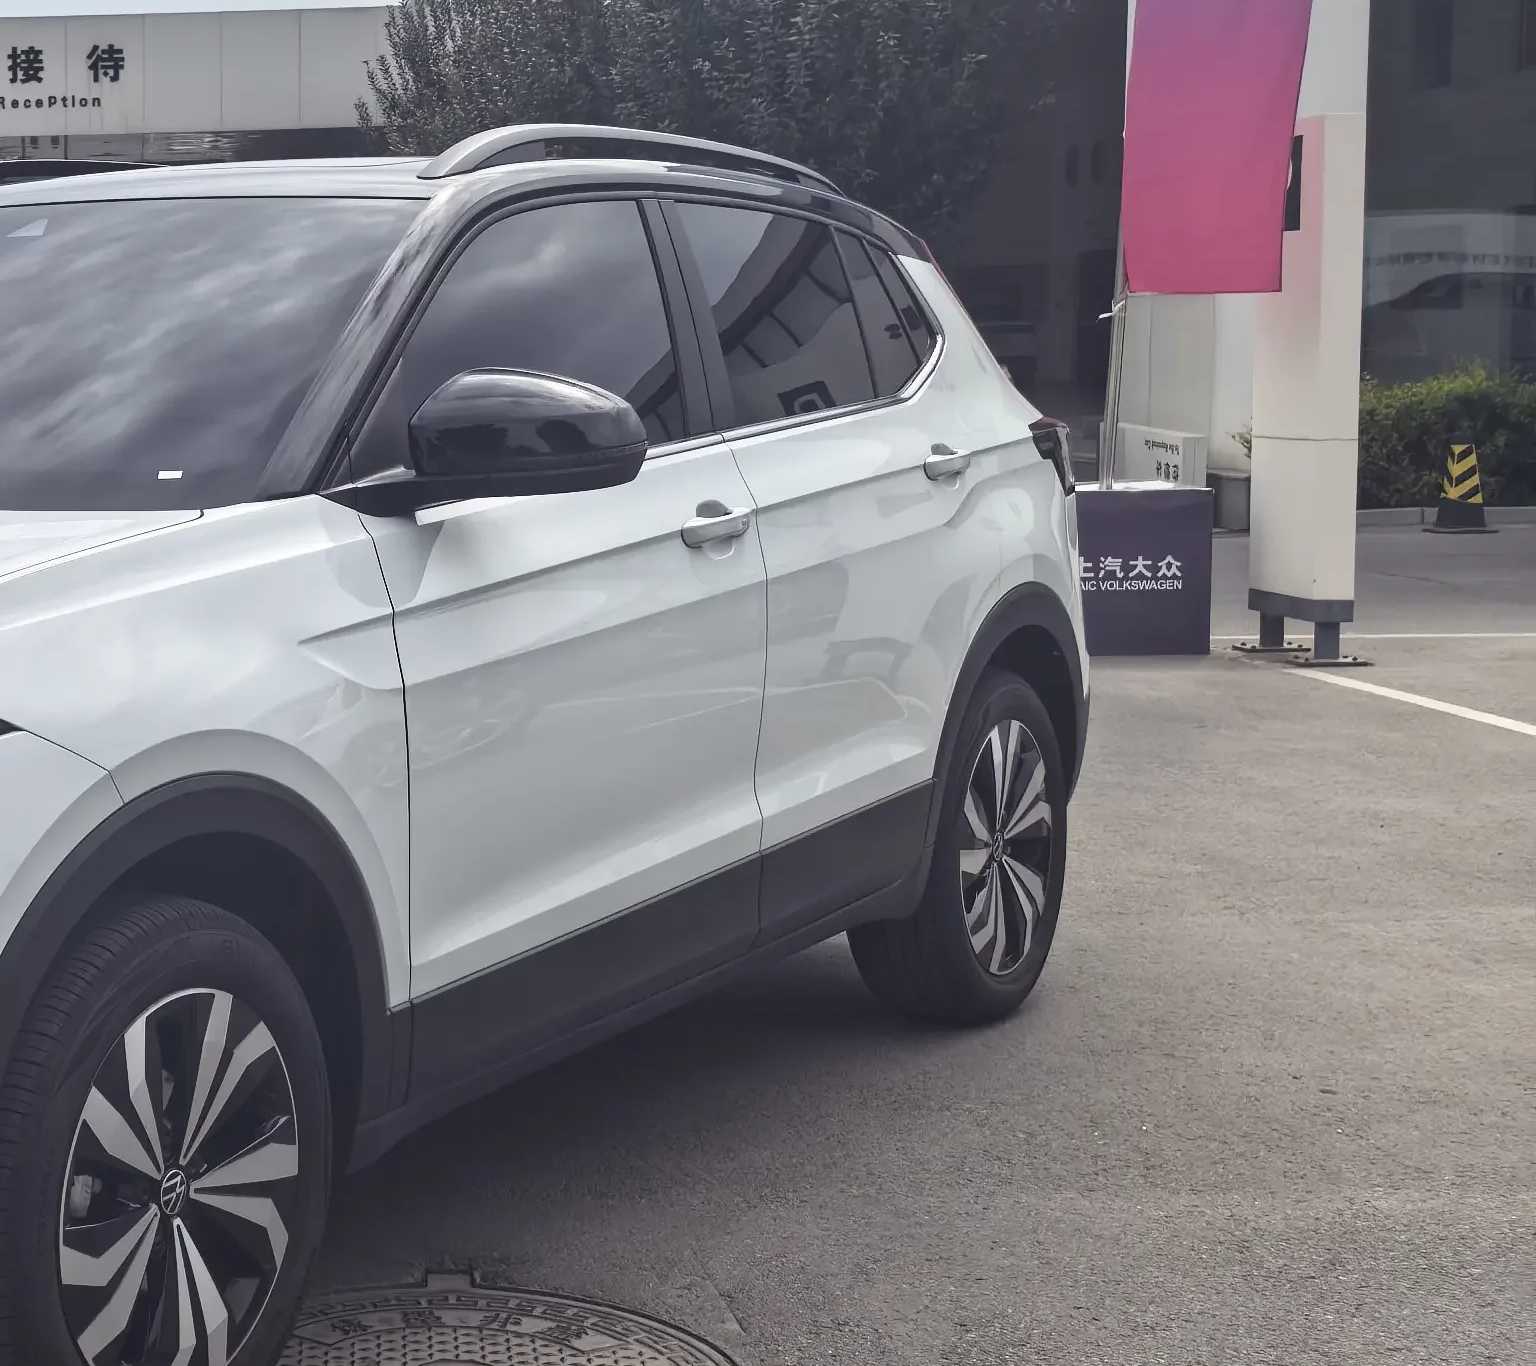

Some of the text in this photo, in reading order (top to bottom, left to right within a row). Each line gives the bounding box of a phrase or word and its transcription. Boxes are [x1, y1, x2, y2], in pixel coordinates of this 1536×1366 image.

[1079, 554, 1182, 578] 上汽大众
[1080, 579, 1183, 591] AIC VOLKSWAGEN
